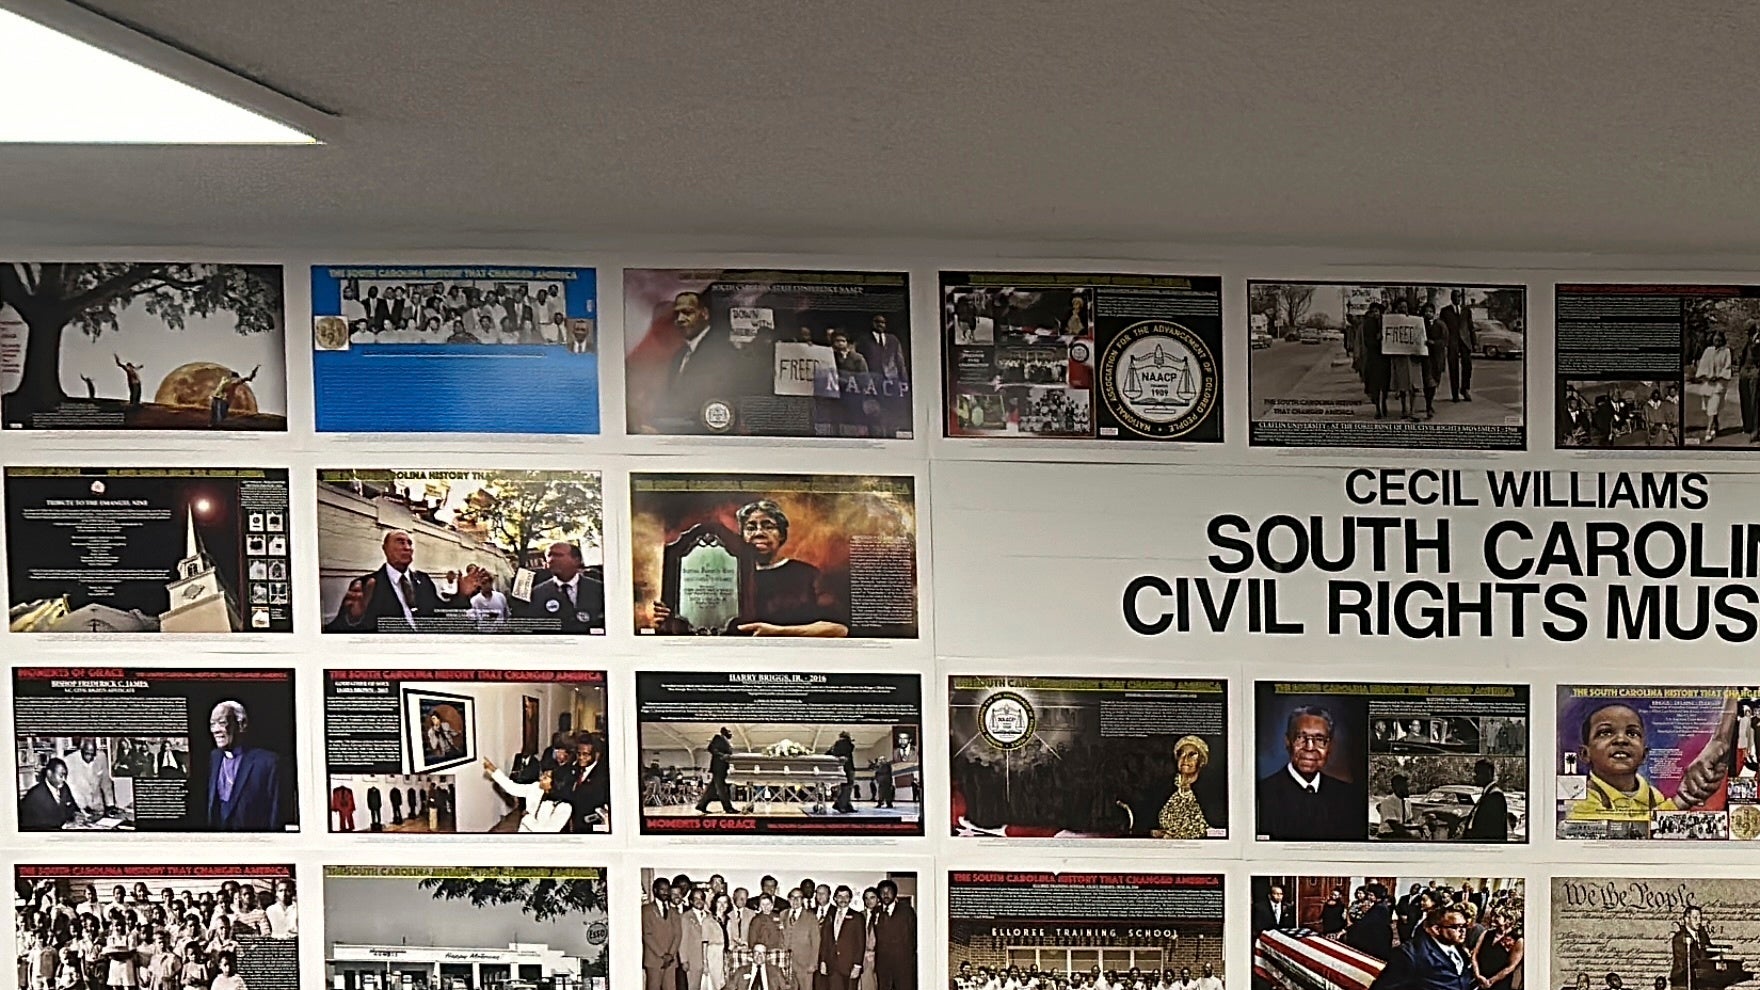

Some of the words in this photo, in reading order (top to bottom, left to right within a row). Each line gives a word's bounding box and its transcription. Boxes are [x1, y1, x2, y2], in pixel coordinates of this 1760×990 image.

[1116, 334, 1132, 349] FOR
[1133, 325, 1149, 336] THE
[1153, 325, 1206, 358] ADVANCEMENT
[1105, 349, 1118, 402] ASSOCIATION
[1142, 372, 1177, 382] NAACP
[1203, 362, 1213, 373] OF
[825, 374, 909, 397] NAACP
[1196, 377, 1213, 413] COLORED
[1116, 404, 1151, 432] NATIONAL
[1168, 413, 1198, 433] PEOPLE
[1344, 468, 1478, 507] CECIL
[1487, 471, 1709, 510] WILLIAMS
[1207, 514, 1449, 575] SOUTH
[1122, 575, 1304, 636] CIVIL
[1327, 579, 1588, 643] RIGHTS
[729, 674, 757, 682] HARRY
[1563, 880, 1596, 907] We
[1629, 881, 1695, 909] People
[992, 927, 1044, 937] ELLOREE
[1056, 928, 1117, 937] TRAINING
[1128, 928, 1177, 938] SCHOOL
